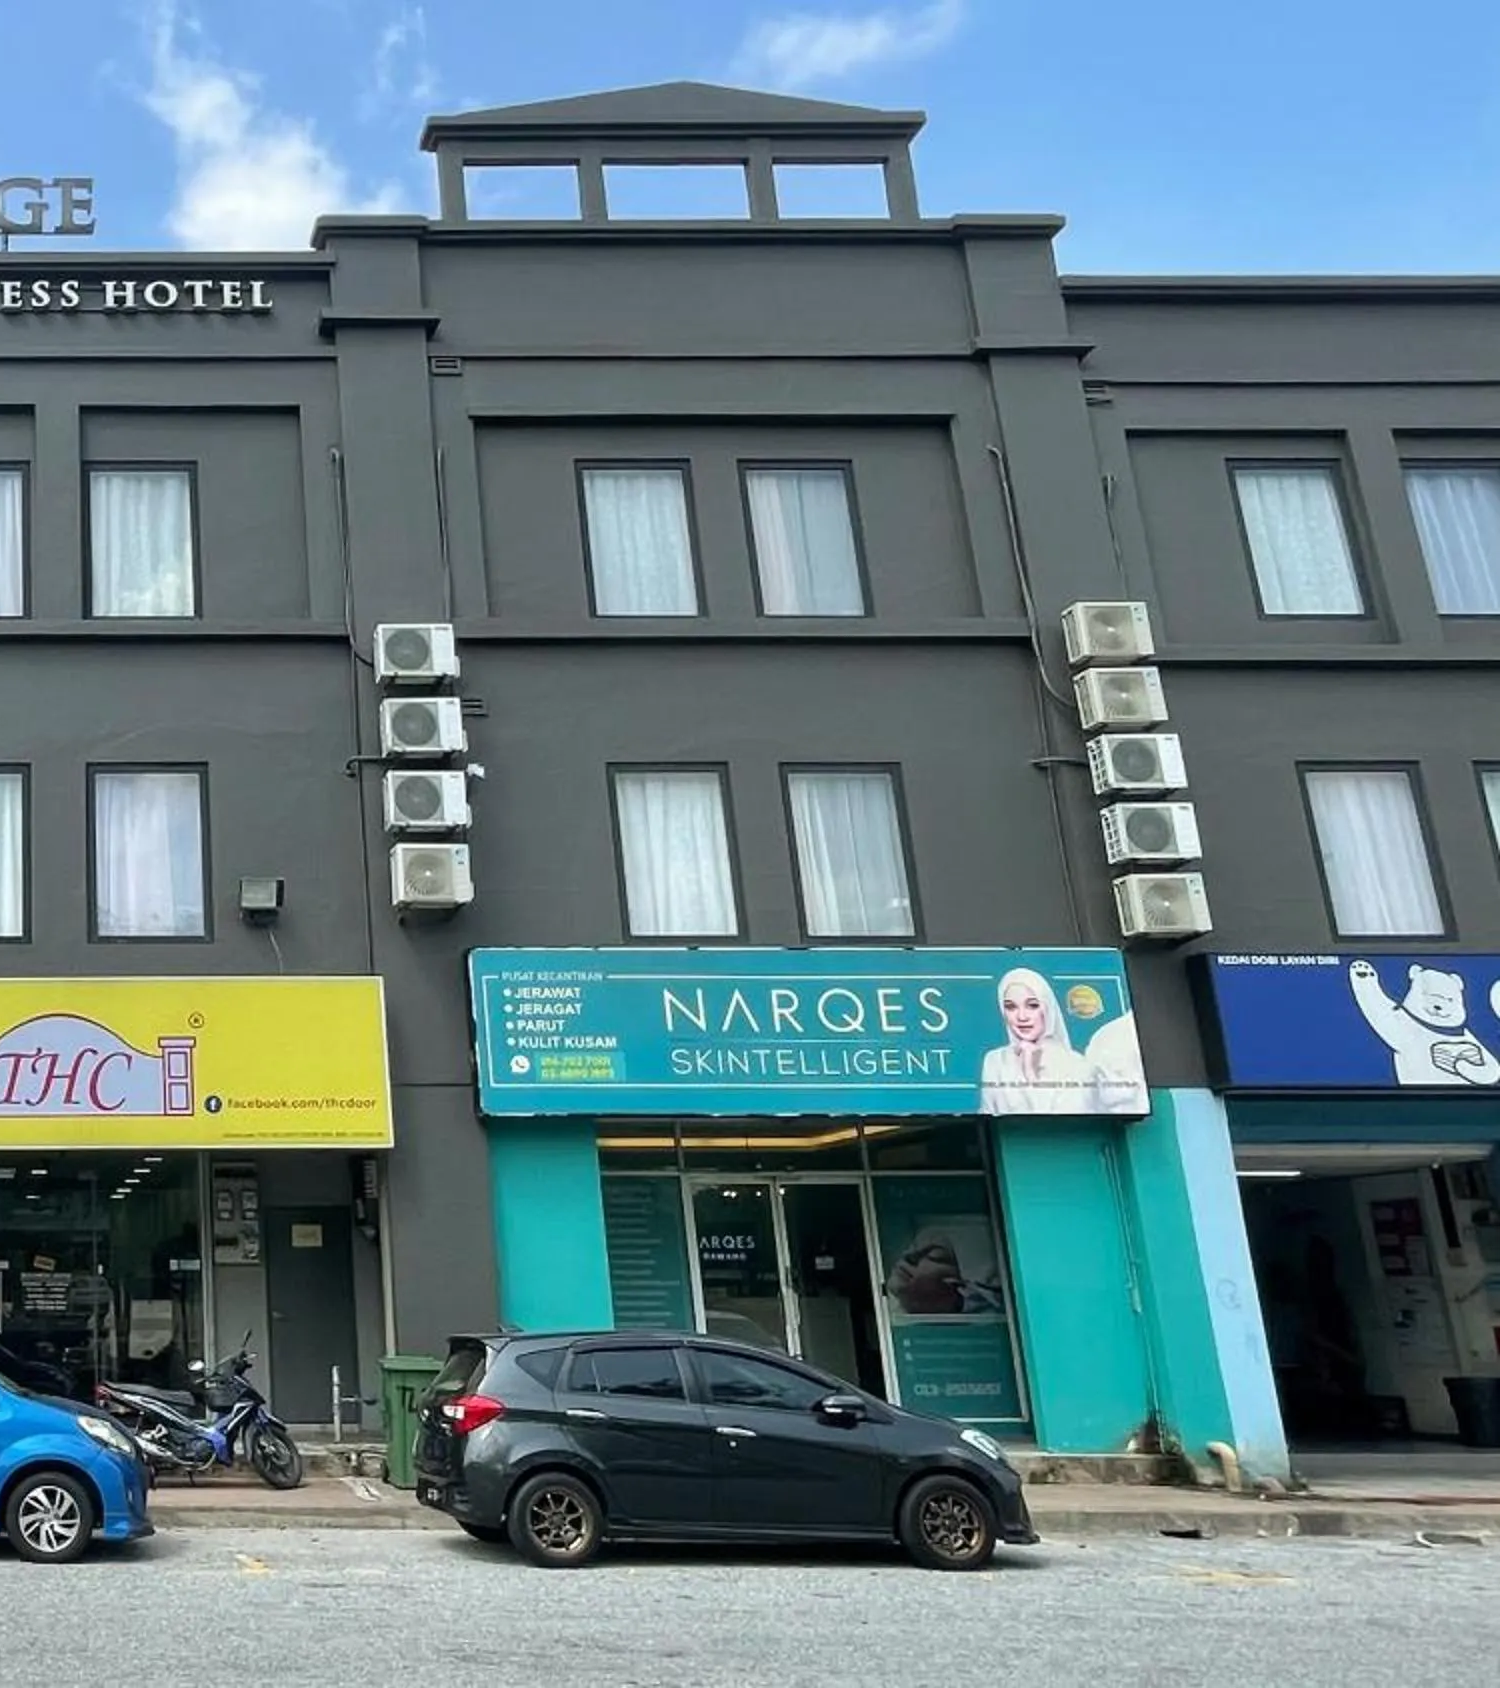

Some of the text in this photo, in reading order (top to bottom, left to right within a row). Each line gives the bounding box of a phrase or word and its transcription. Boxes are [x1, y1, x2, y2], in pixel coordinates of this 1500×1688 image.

[103, 280, 273, 308] HOTEL
[514, 987, 581, 999] JERAWAT
[516, 1003, 582, 1015] JERAGAT
[663, 987, 949, 1033] NARQES
[517, 1019, 565, 1032] PARUT
[518, 1036, 617, 1049] KULIT KUSAM
[671, 1048, 951, 1075] SKINTELLIGENT
[227, 1097, 376, 1110] facebook.com/thcdoor
[699, 1235, 756, 1249] ARQES
